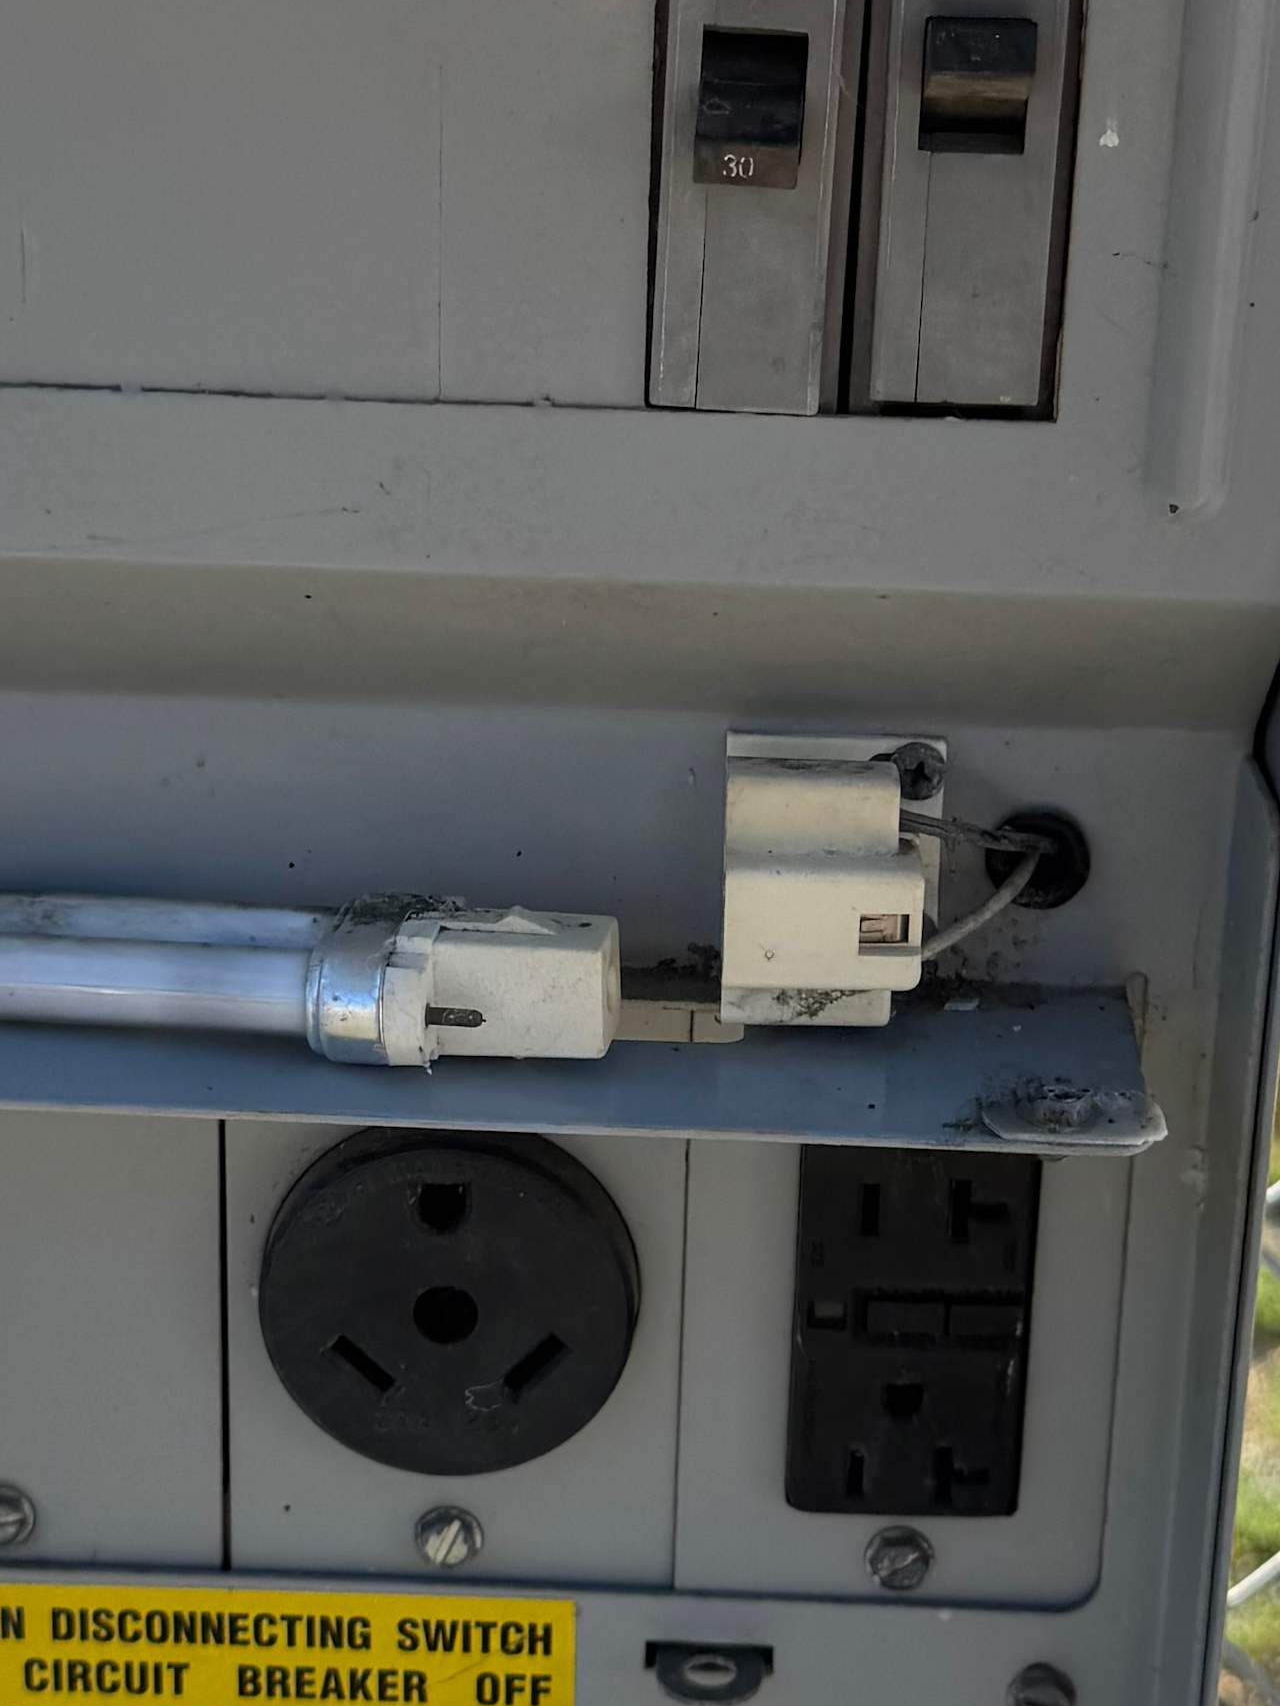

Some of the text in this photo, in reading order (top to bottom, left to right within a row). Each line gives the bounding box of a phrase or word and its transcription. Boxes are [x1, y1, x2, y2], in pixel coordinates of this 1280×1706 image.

[722, 154, 754, 178] 30
[51, 1607, 371, 1651] DISCONNECTING
[397, 1618, 553, 1657] SWITCH
[23, 1658, 190, 1696] CIRCUIT
[237, 1664, 428, 1704] BREAKER
